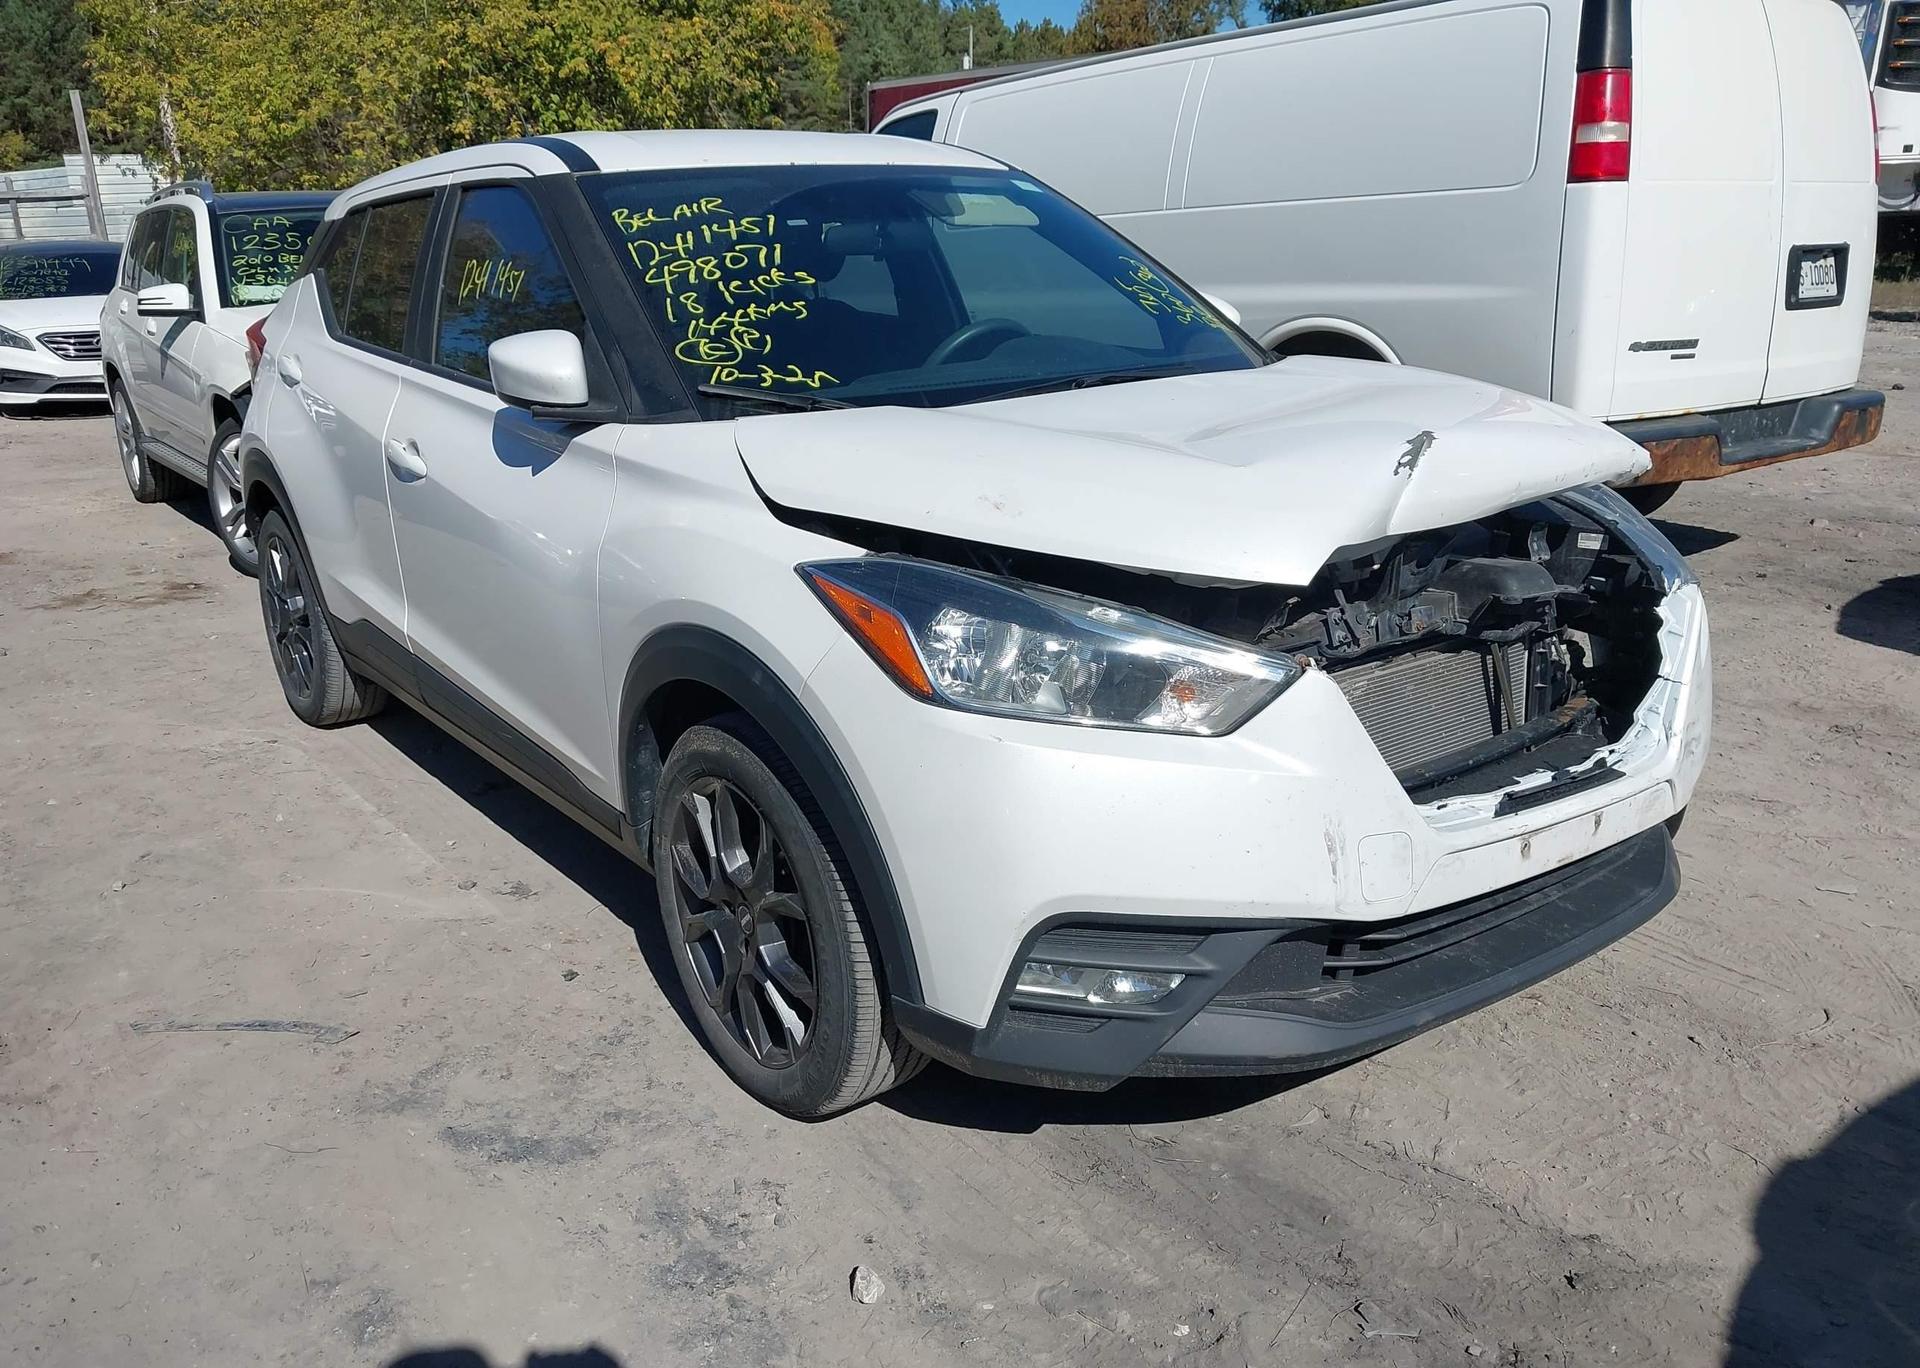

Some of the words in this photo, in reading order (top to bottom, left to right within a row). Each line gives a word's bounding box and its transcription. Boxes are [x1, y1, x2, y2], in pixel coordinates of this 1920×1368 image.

[673, 197, 734, 221] AIR
[222, 214, 294, 234] CAA
[232, 254, 274, 267] 2010
[644, 242, 782, 295] 498071
[666, 292, 704, 323] 18
